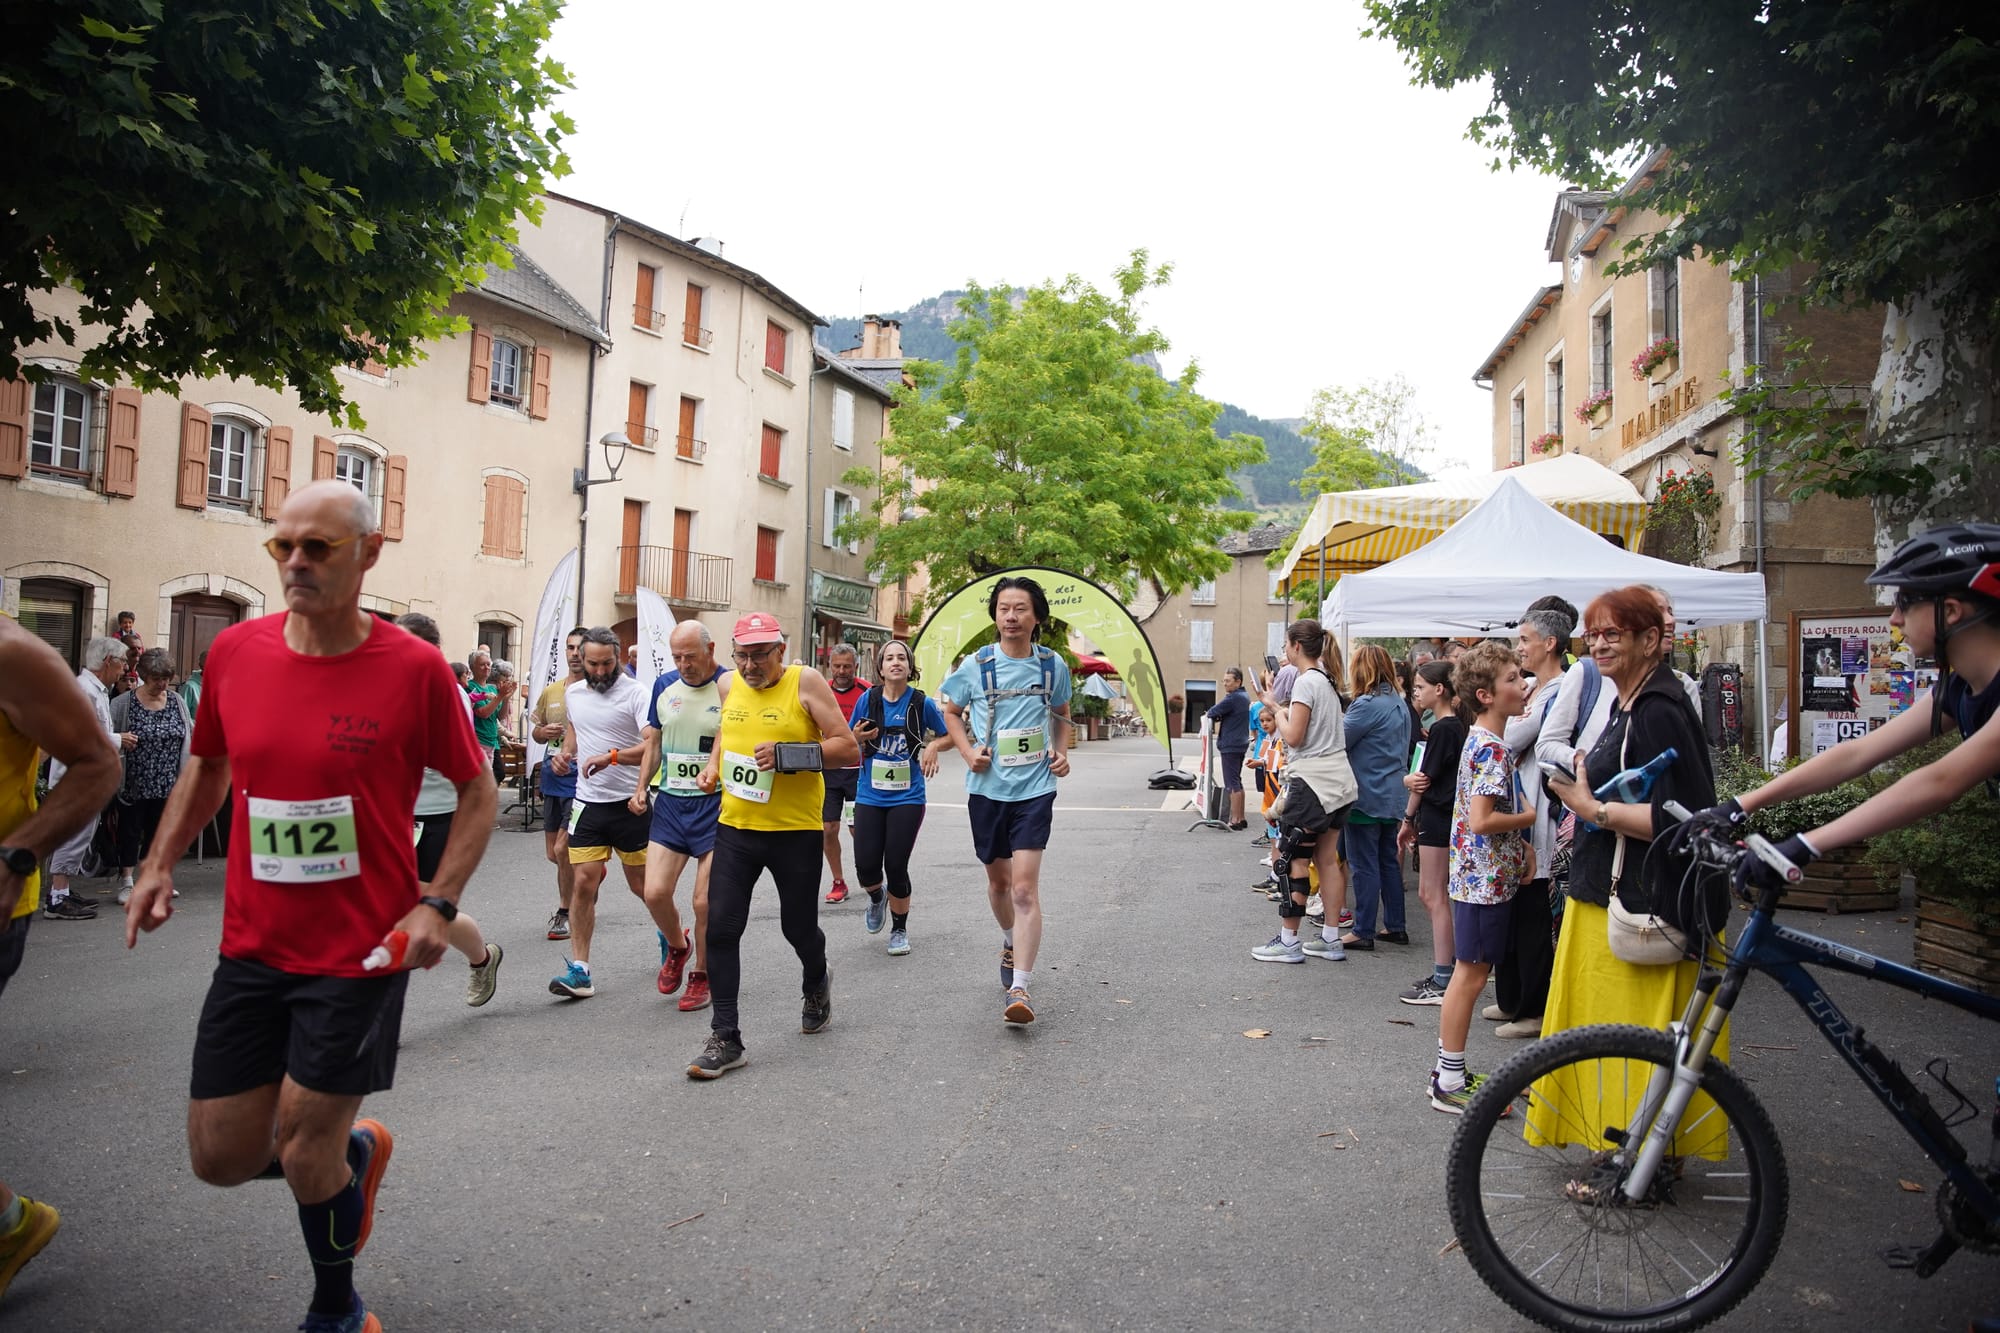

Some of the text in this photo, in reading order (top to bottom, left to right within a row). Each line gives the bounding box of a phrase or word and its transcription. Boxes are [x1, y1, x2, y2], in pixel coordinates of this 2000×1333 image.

[1622, 376, 1697, 449] MAIRIE
[1055, 584, 1075, 594] des
[1803, 626, 1889, 635] LA CAFETERA ROJA
[1839, 722, 1867, 738] 05
[1018, 738, 1029, 753] 5
[677, 763, 700, 778] 90
[732, 765, 758, 786] 60
[885, 769, 895, 781] 4
[262, 821, 340, 855] 112
